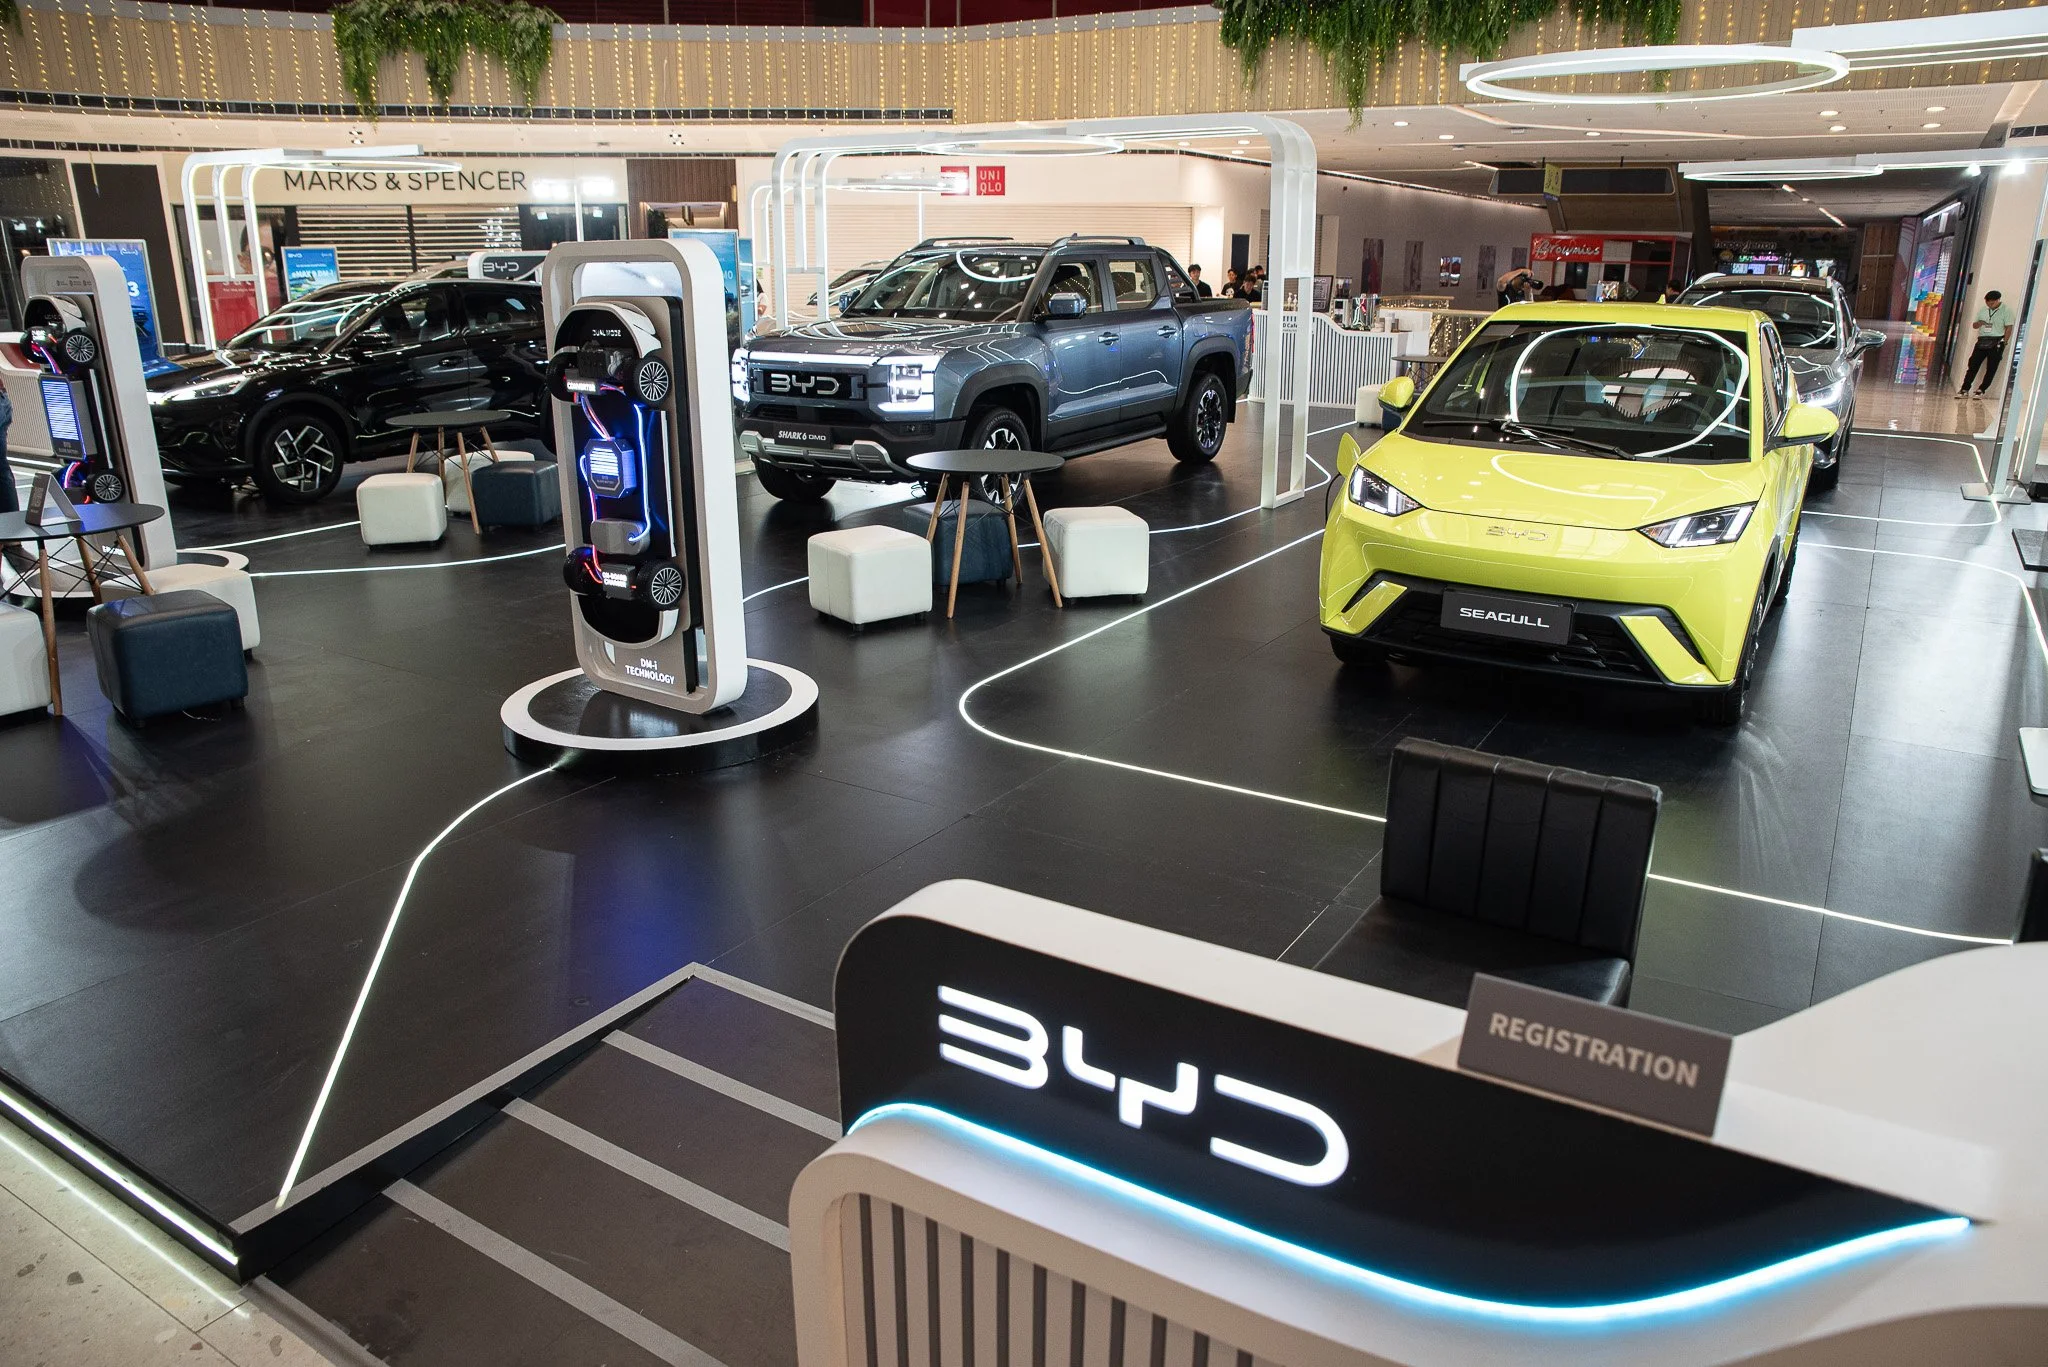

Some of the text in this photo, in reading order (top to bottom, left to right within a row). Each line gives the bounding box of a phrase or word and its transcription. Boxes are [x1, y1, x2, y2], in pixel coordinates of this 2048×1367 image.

[284, 170, 527, 191] MARKS & SPENCER
[980, 170, 1000, 181] UNI
[980, 182, 1002, 194] QLO
[483, 262, 520, 273] BYD
[128, 281, 140, 297] 3
[771, 373, 839, 395] BYD
[778, 430, 802, 440] SHARK
[802, 432, 807, 440] 6
[1486, 525, 1549, 542] BYD
[1460, 607, 1550, 628] SEAGULL
[641, 658, 657, 669] DM-i
[625, 665, 675, 685] TECHNOLOGY
[1488, 1012, 1699, 1088] REGISTRATION
[937, 984, 1350, 1187] BYD
